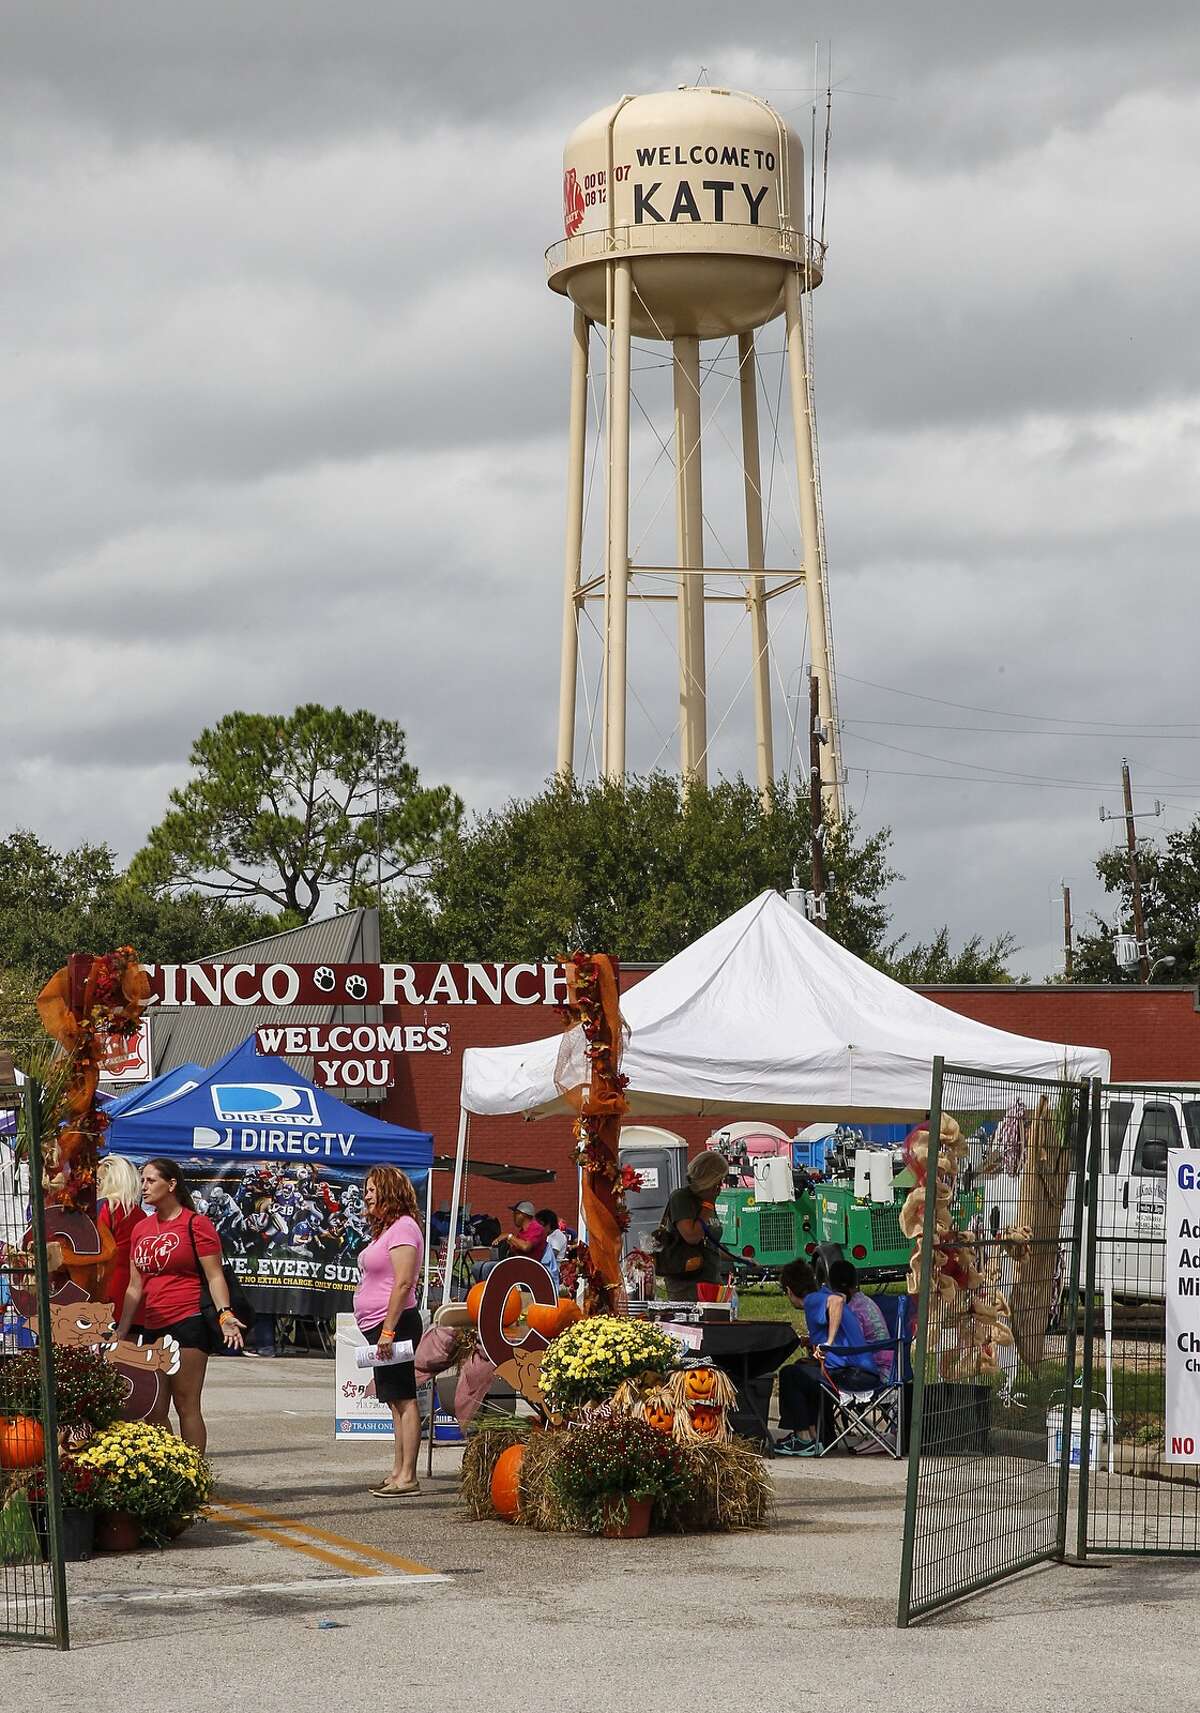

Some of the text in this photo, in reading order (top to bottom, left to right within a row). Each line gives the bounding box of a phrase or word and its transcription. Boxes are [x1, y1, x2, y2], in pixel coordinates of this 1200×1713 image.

[636, 146, 776, 171] WELCOME TO
[634, 180, 769, 225] KATY
[138, 963, 570, 1006] CINCO RANCH
[258, 1026, 448, 1054] WELCOMES
[318, 1059, 390, 1087] YOU
[222, 1112, 315, 1125] DIRECTV
[1179, 1218, 1200, 1238] Ad
[257, 1258, 322, 1278] EVERY
[1179, 1248, 1200, 1268] Ad
[257, 1276, 282, 1285] EXTRA
[1178, 1277, 1200, 1296] Mi
[1177, 1332, 1200, 1352] Ch
[1185, 1358, 1200, 1372] Ch
[352, 1422, 377, 1430] TRASH
[1171, 1437, 1195, 1455] NO
